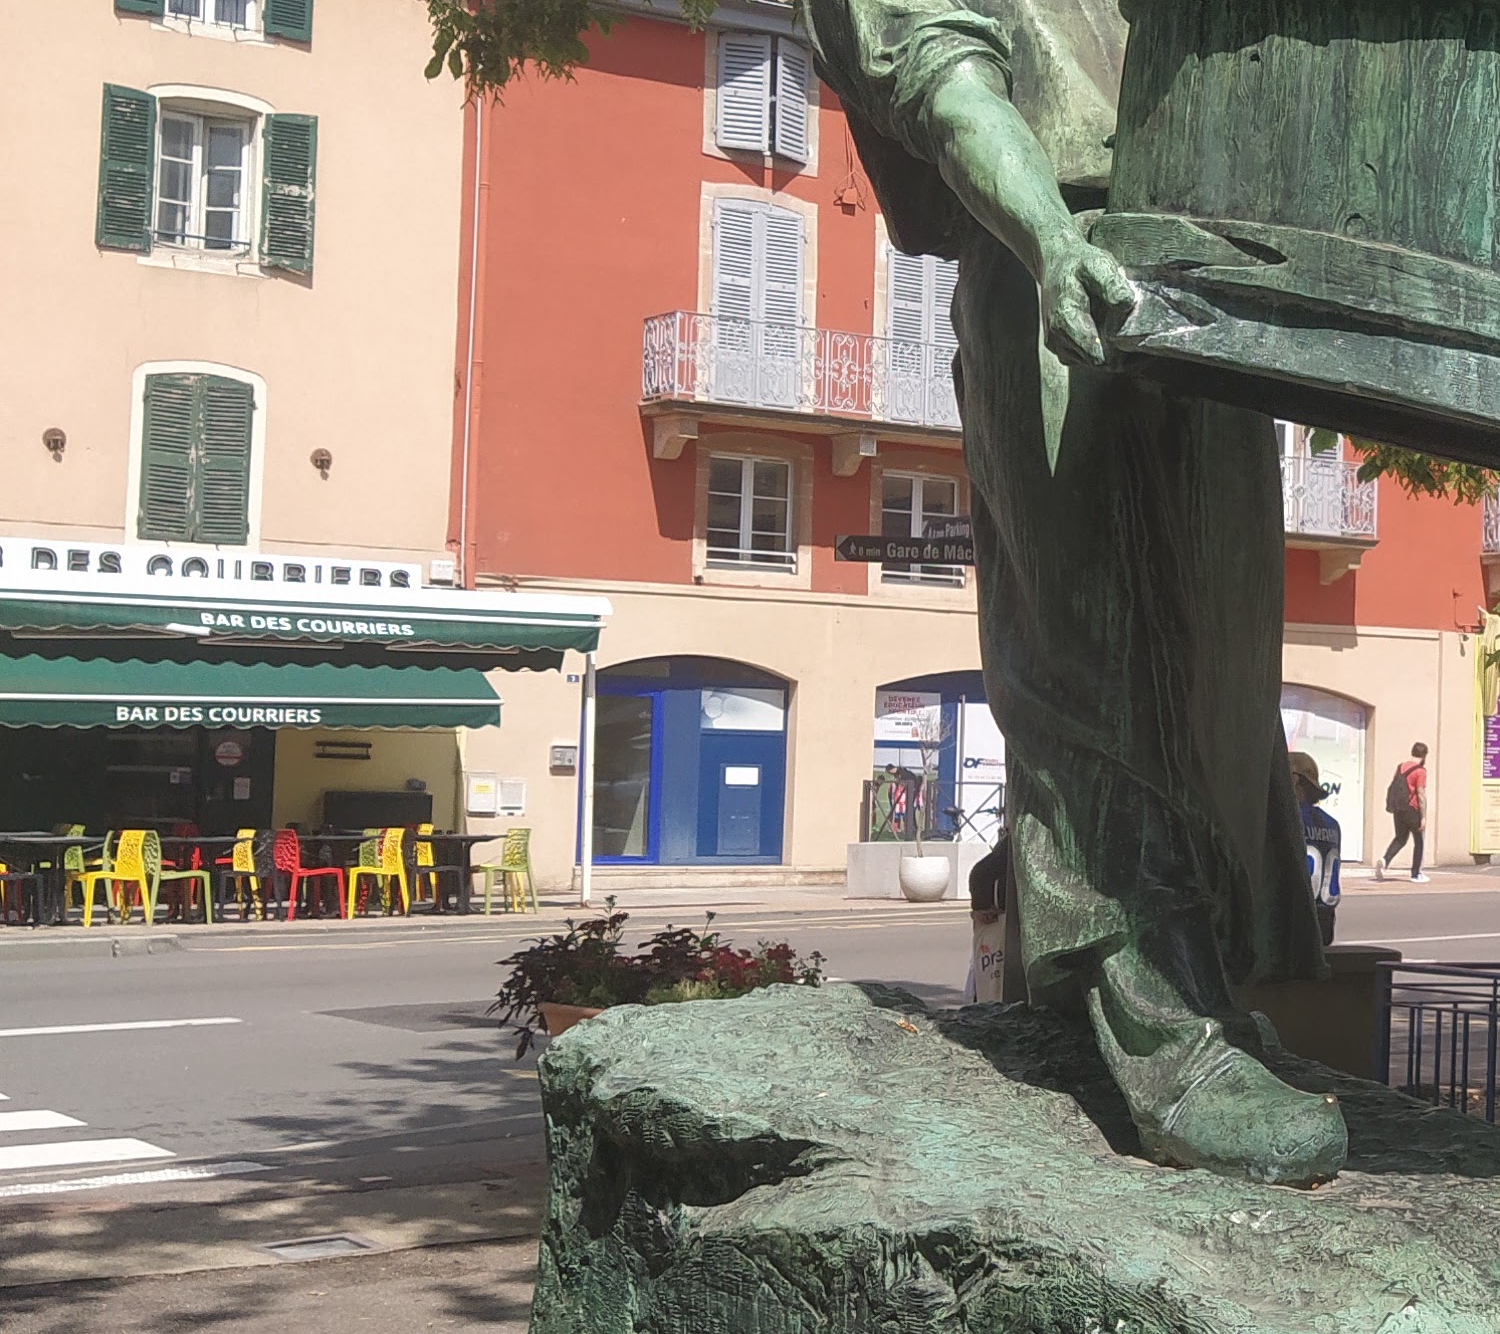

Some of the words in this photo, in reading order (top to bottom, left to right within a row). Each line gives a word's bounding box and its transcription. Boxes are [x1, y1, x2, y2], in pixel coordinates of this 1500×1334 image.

[945, 521, 970, 539] Parking
[865, 547, 881, 556] min
[886, 542, 919, 559] Gare
[923, 543, 939, 559] de
[943, 543, 975, 561] Mâc
[31, 546, 123, 574] DES
[146, 553, 411, 589] COURRIERS
[200, 612, 246, 628] BAR
[250, 615, 292, 631] DES
[296, 618, 415, 636] COURRIERS
[116, 705, 159, 722] BAR
[164, 706, 204, 723] DES
[208, 707, 322, 723] COURRIERS
